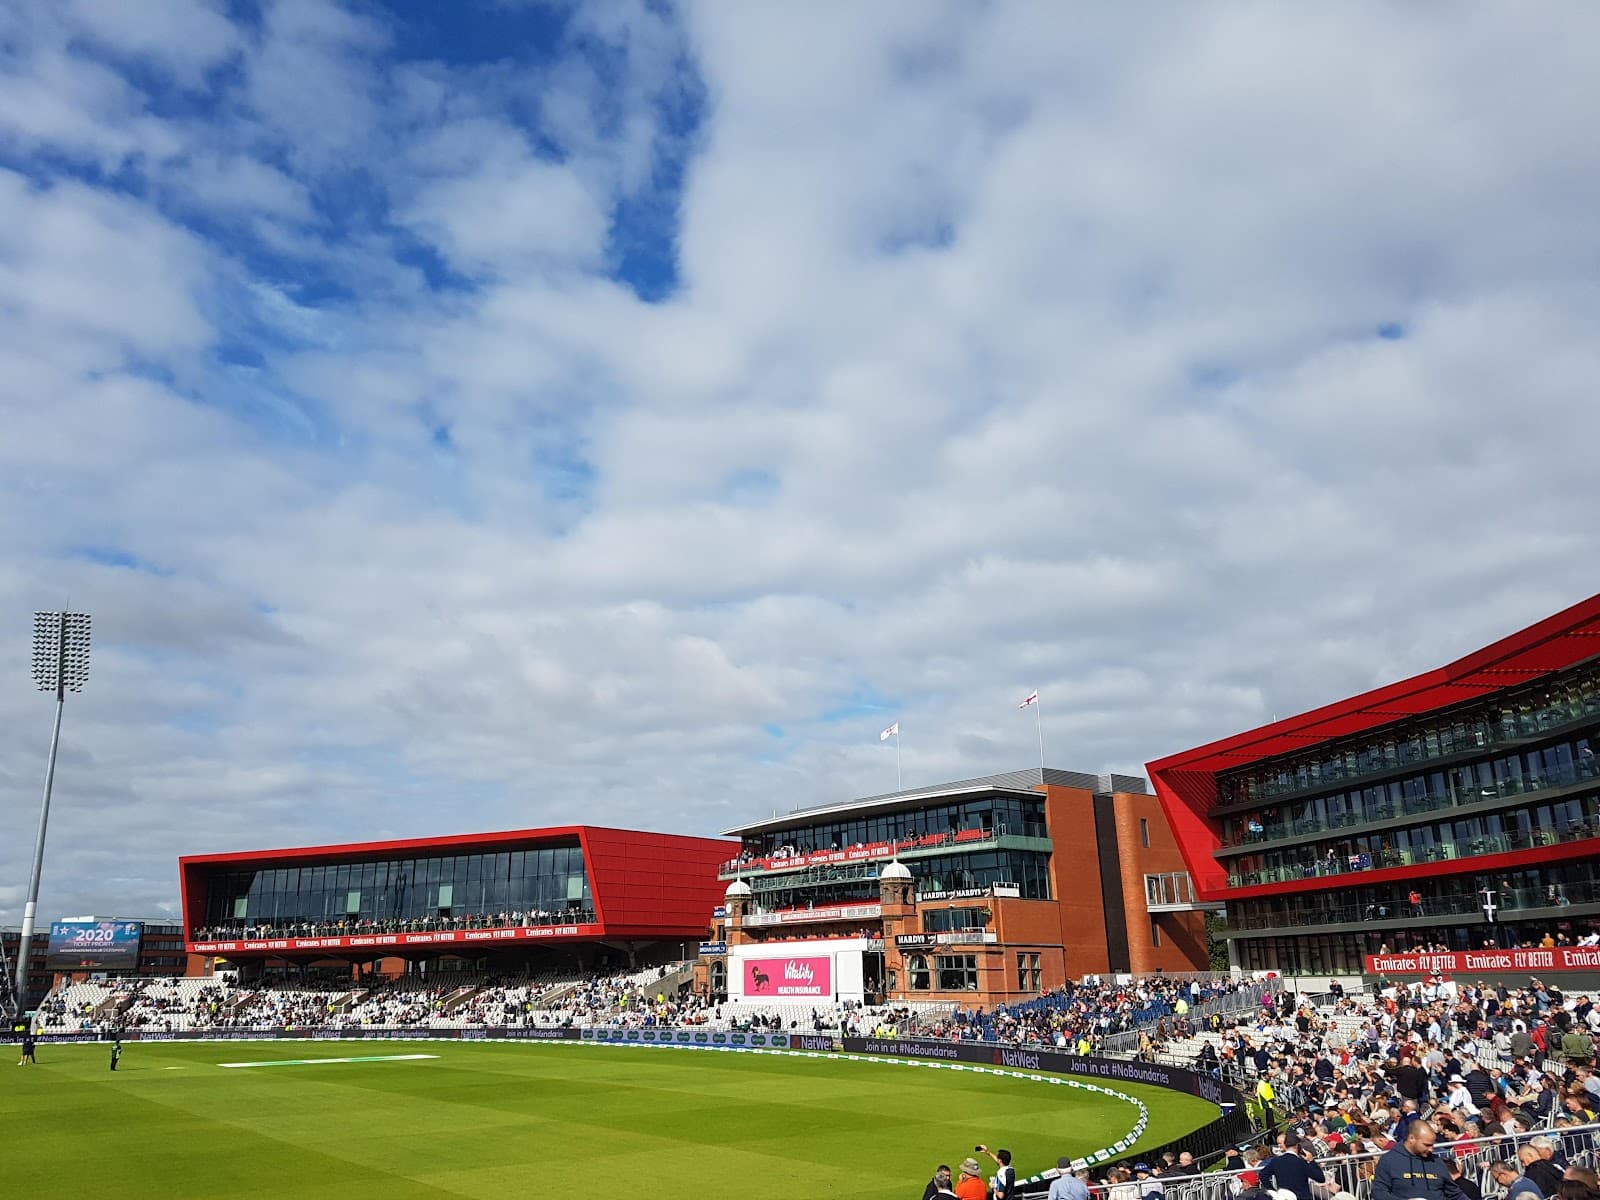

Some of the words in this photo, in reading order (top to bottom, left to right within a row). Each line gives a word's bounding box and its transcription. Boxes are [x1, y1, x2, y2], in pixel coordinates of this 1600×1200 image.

[76, 929, 114, 941] 2020
[465, 931, 491, 940] Emirates
[526, 928, 553, 937] Emirates
[406, 935, 432, 943] Emirates
[898, 935, 925, 944] HARDYS
[1373, 956, 1416, 971] Emirates
[1419, 955, 1432, 970] FLY
[1432, 955, 1457, 970] BETTER
[1465, 954, 1512, 969] Emirates
[1515, 953, 1528, 968] FLY
[1528, 951, 1554, 967] BETTER
[784, 959, 814, 986] Vitality
[777, 986, 795, 994] HEALTH
[795, 986, 821, 994] INSURANCE
[312, 1031, 341, 1039] NatWest
[865, 1043, 880, 1052] Join
[881, 1043, 889, 1052] in
[890, 1045, 898, 1053] at
[900, 1044, 958, 1058] #NoBoundaries
[1002, 1049, 1040, 1069] NatWest
[1070, 1059, 1088, 1072] Join
[1089, 1060, 1098, 1074] in
[1100, 1064, 1110, 1075] at
[1112, 1063, 1170, 1084] #NoBoundaries
